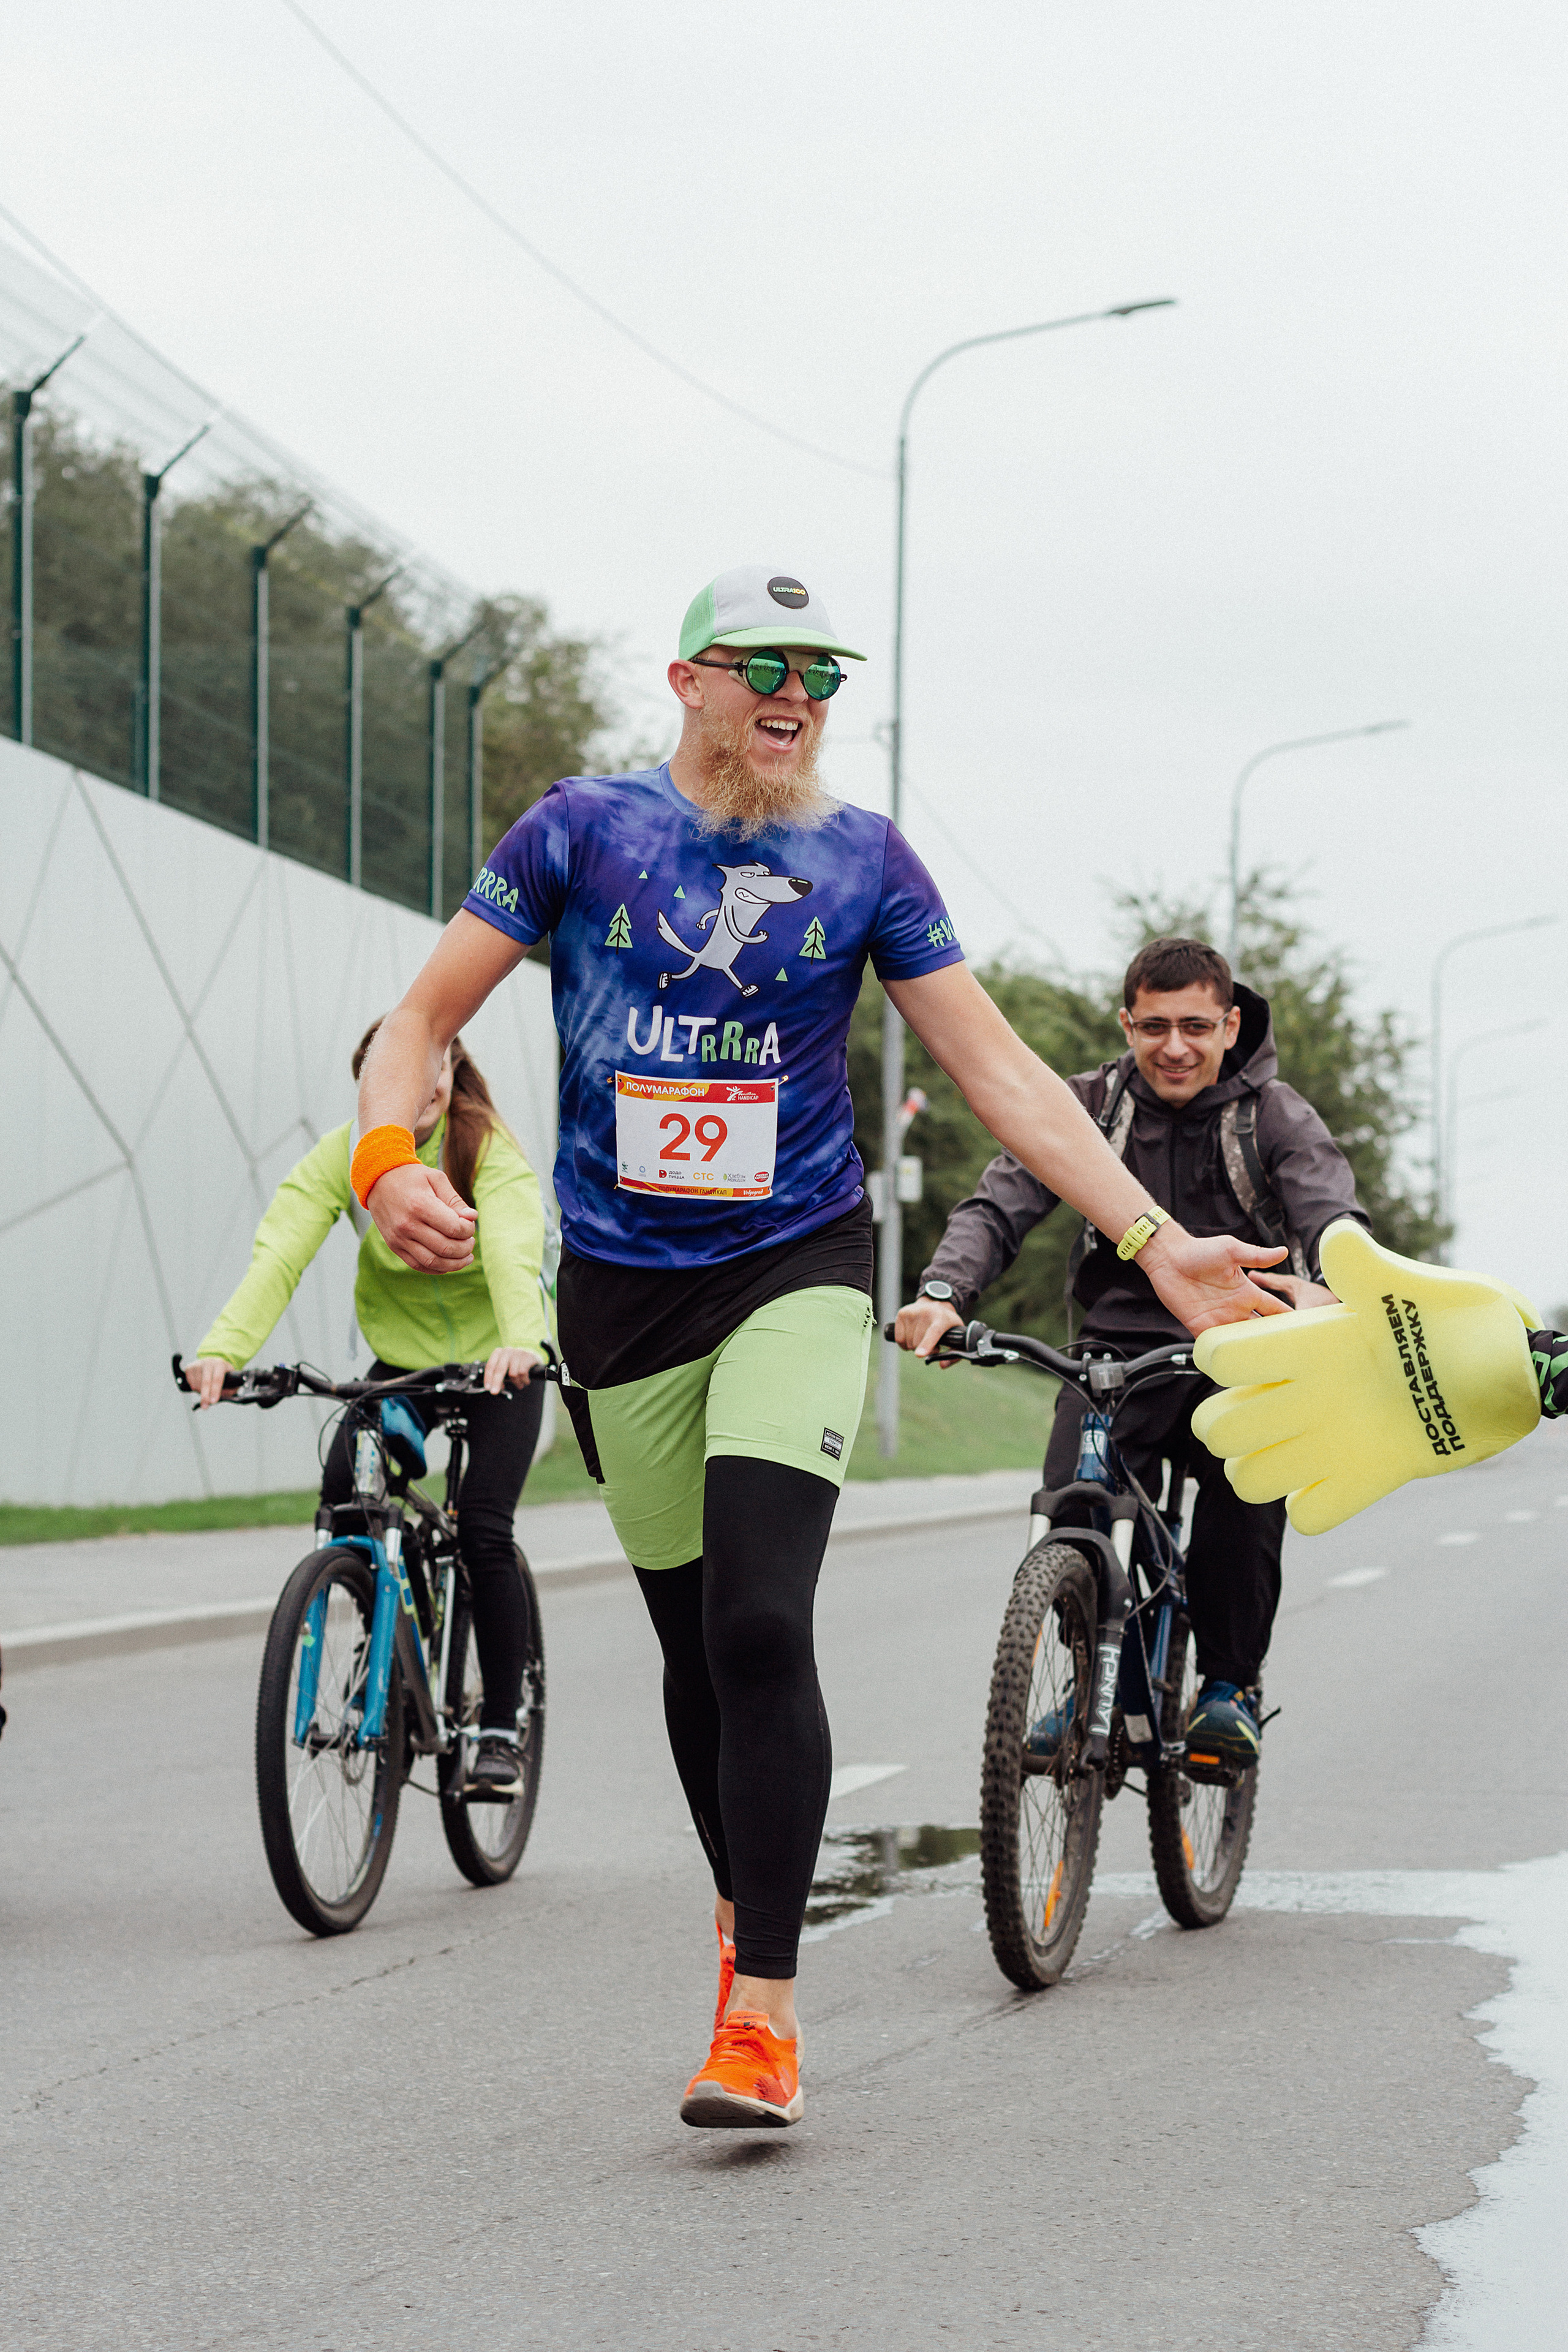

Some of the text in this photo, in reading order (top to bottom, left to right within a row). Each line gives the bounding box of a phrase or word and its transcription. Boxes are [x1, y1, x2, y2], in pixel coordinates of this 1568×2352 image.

[473, 867, 519, 913] RRRA
[627, 1005, 782, 1066] ULTRRRA
[626, 1081, 704, 1097] ПОЛУМАРАФОН
[659, 1113, 728, 1162] 29
[658, 1185, 698, 1194] ПОЛУМАРАФОН
[1381, 1294, 1451, 1455] ДОСТАВЛЯЕМ
[1401, 1299, 1465, 1452] ПОДДЕРЖКУ
[1089, 1644, 1121, 1736] LAUNCH
